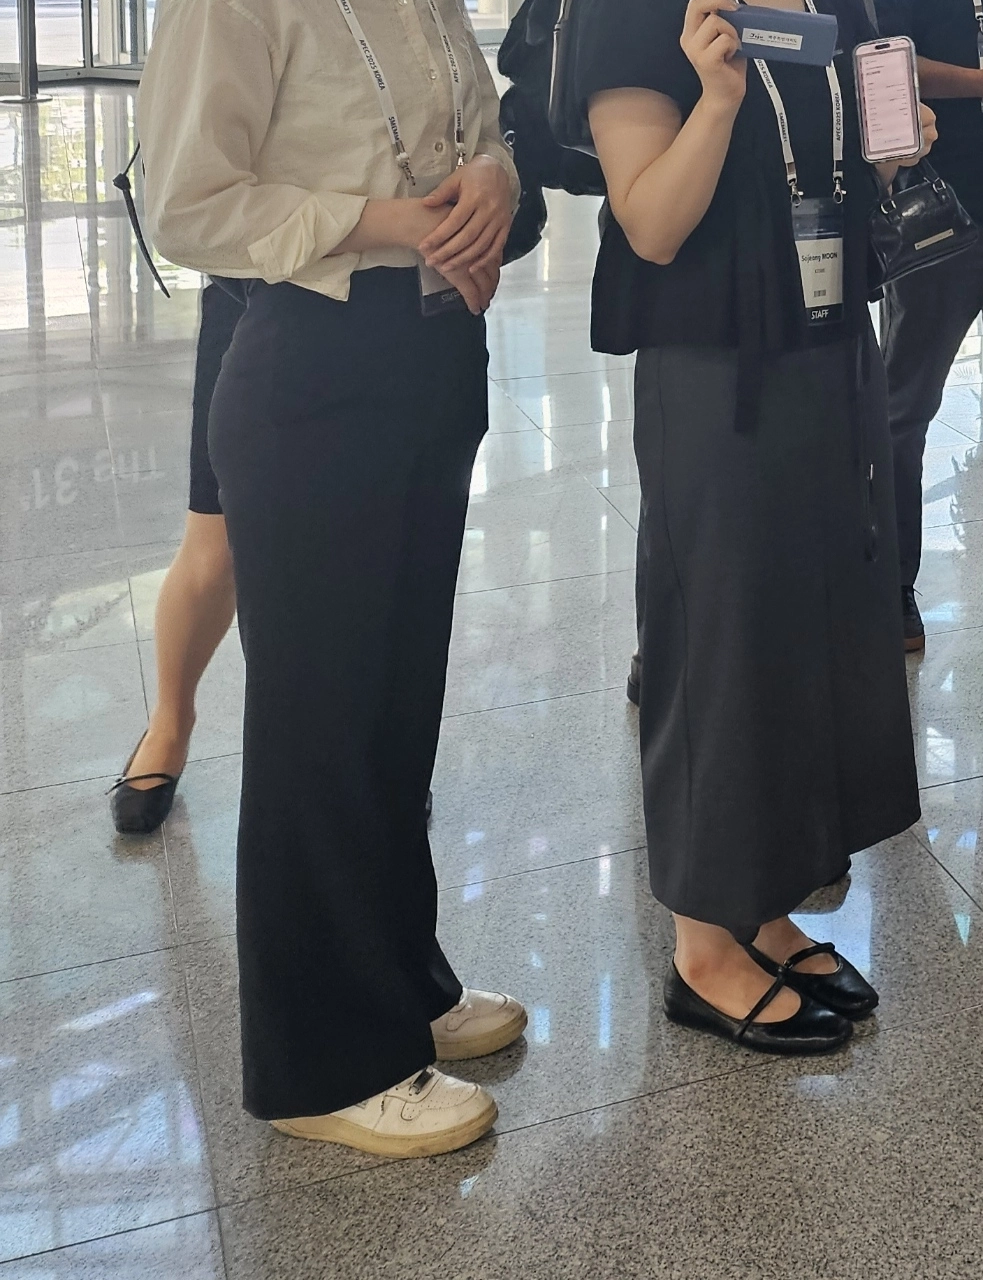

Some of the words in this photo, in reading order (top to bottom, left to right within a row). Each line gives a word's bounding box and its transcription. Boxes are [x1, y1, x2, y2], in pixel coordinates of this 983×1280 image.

[374, 69, 386, 91] KOREA
[821, 252, 838, 260] MOON
[811, 309, 829, 320] STAFF
